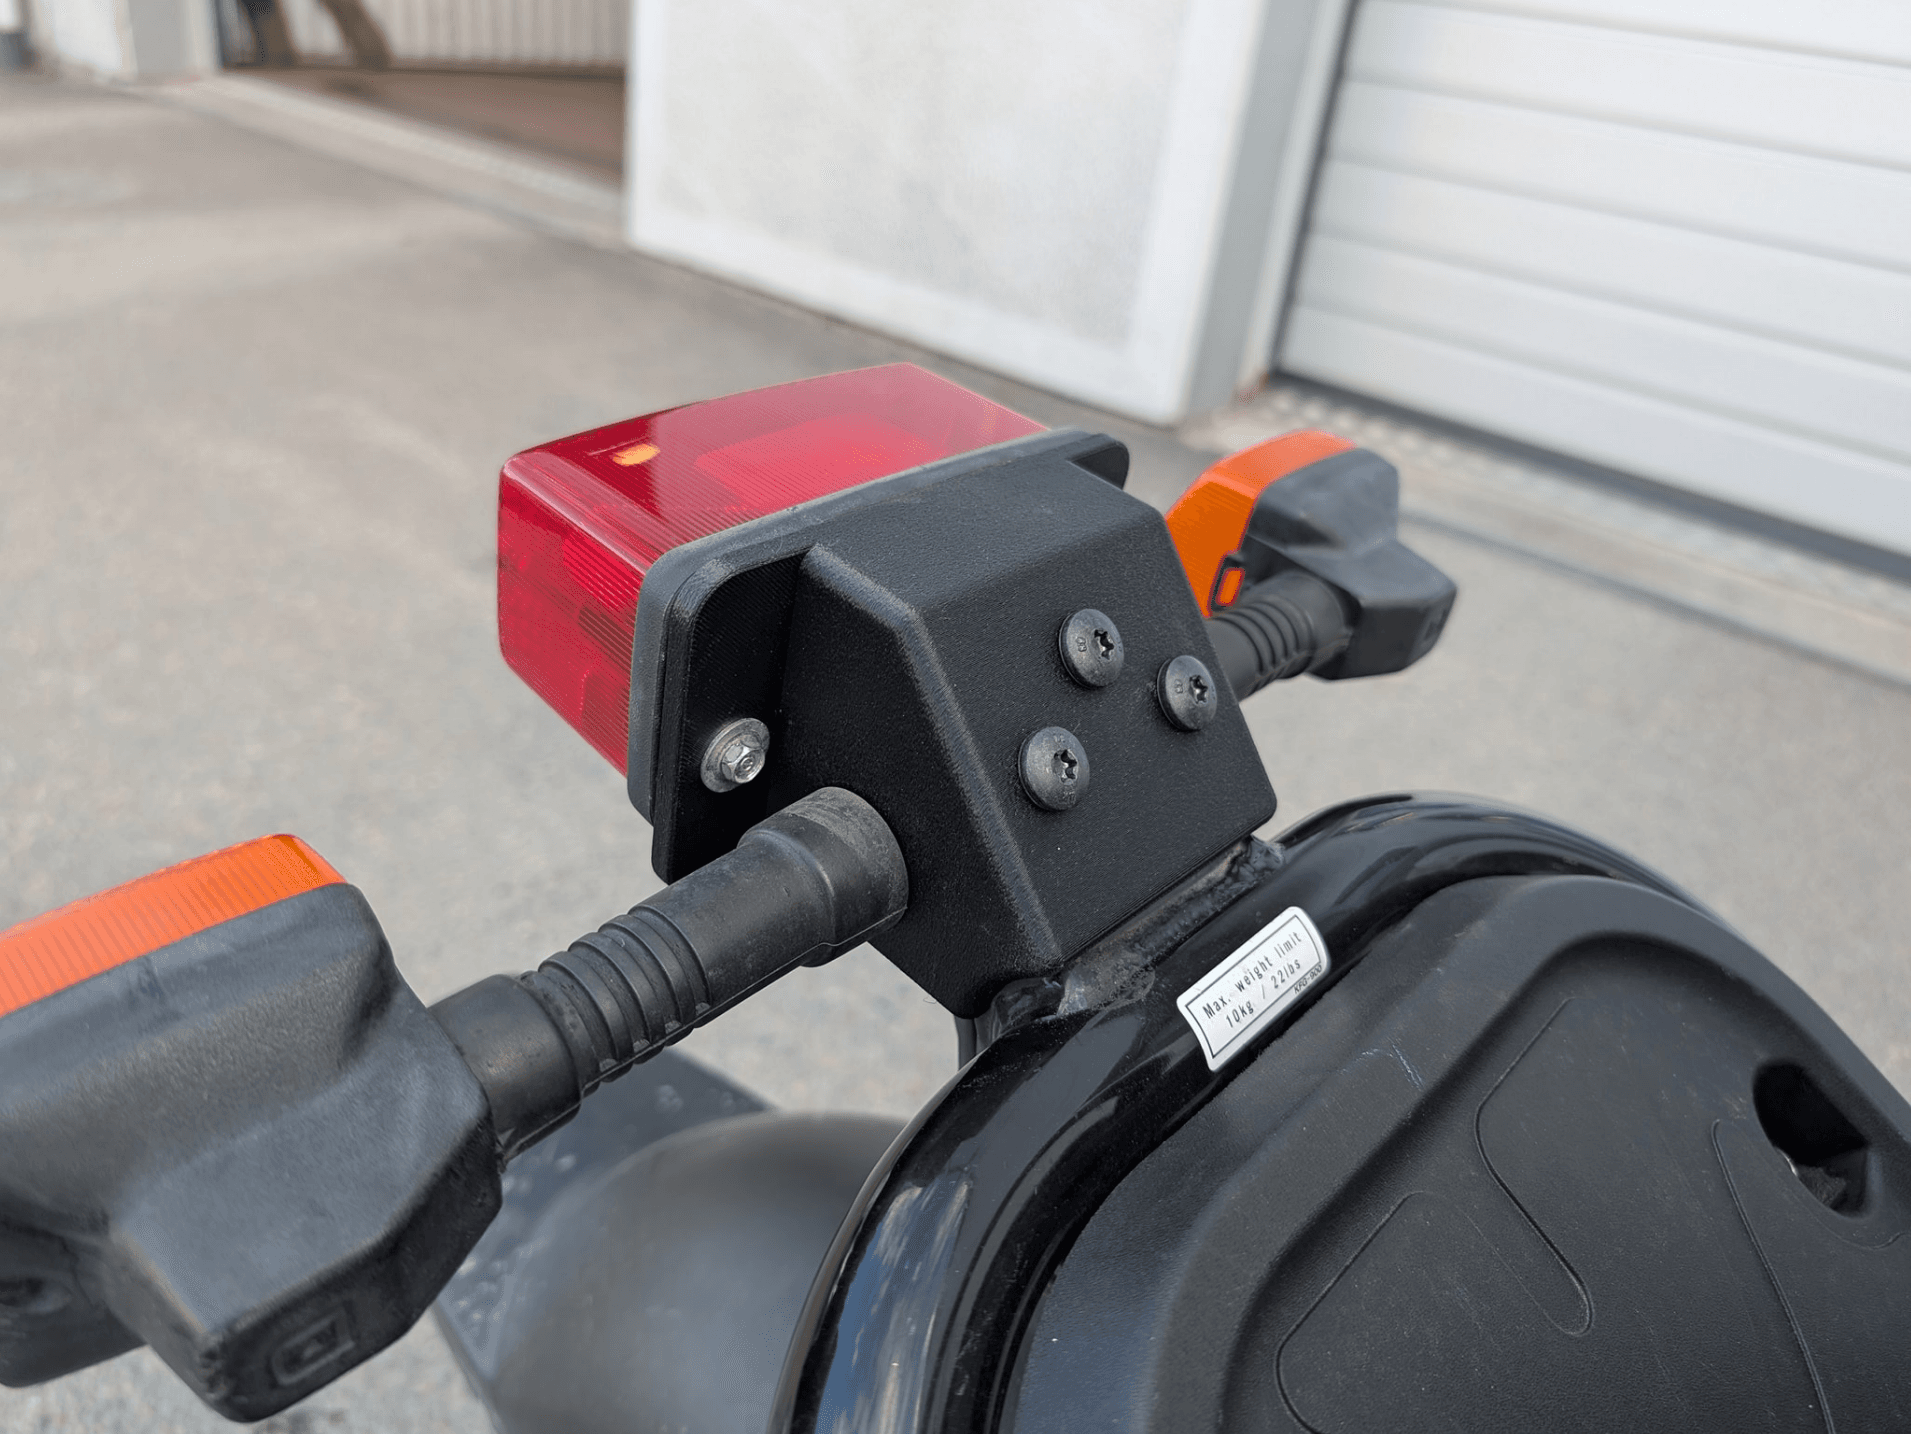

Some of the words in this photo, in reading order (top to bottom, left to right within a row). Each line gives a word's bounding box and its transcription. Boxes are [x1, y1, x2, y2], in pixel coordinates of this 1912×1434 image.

[1202, 994, 1232, 1019] Max.
[1234, 955, 1273, 993] weight
[1274, 931, 1302, 958] limit
[1225, 1000, 1254, 1028] 10kg
[1270, 958, 1301, 989] 22lbs
